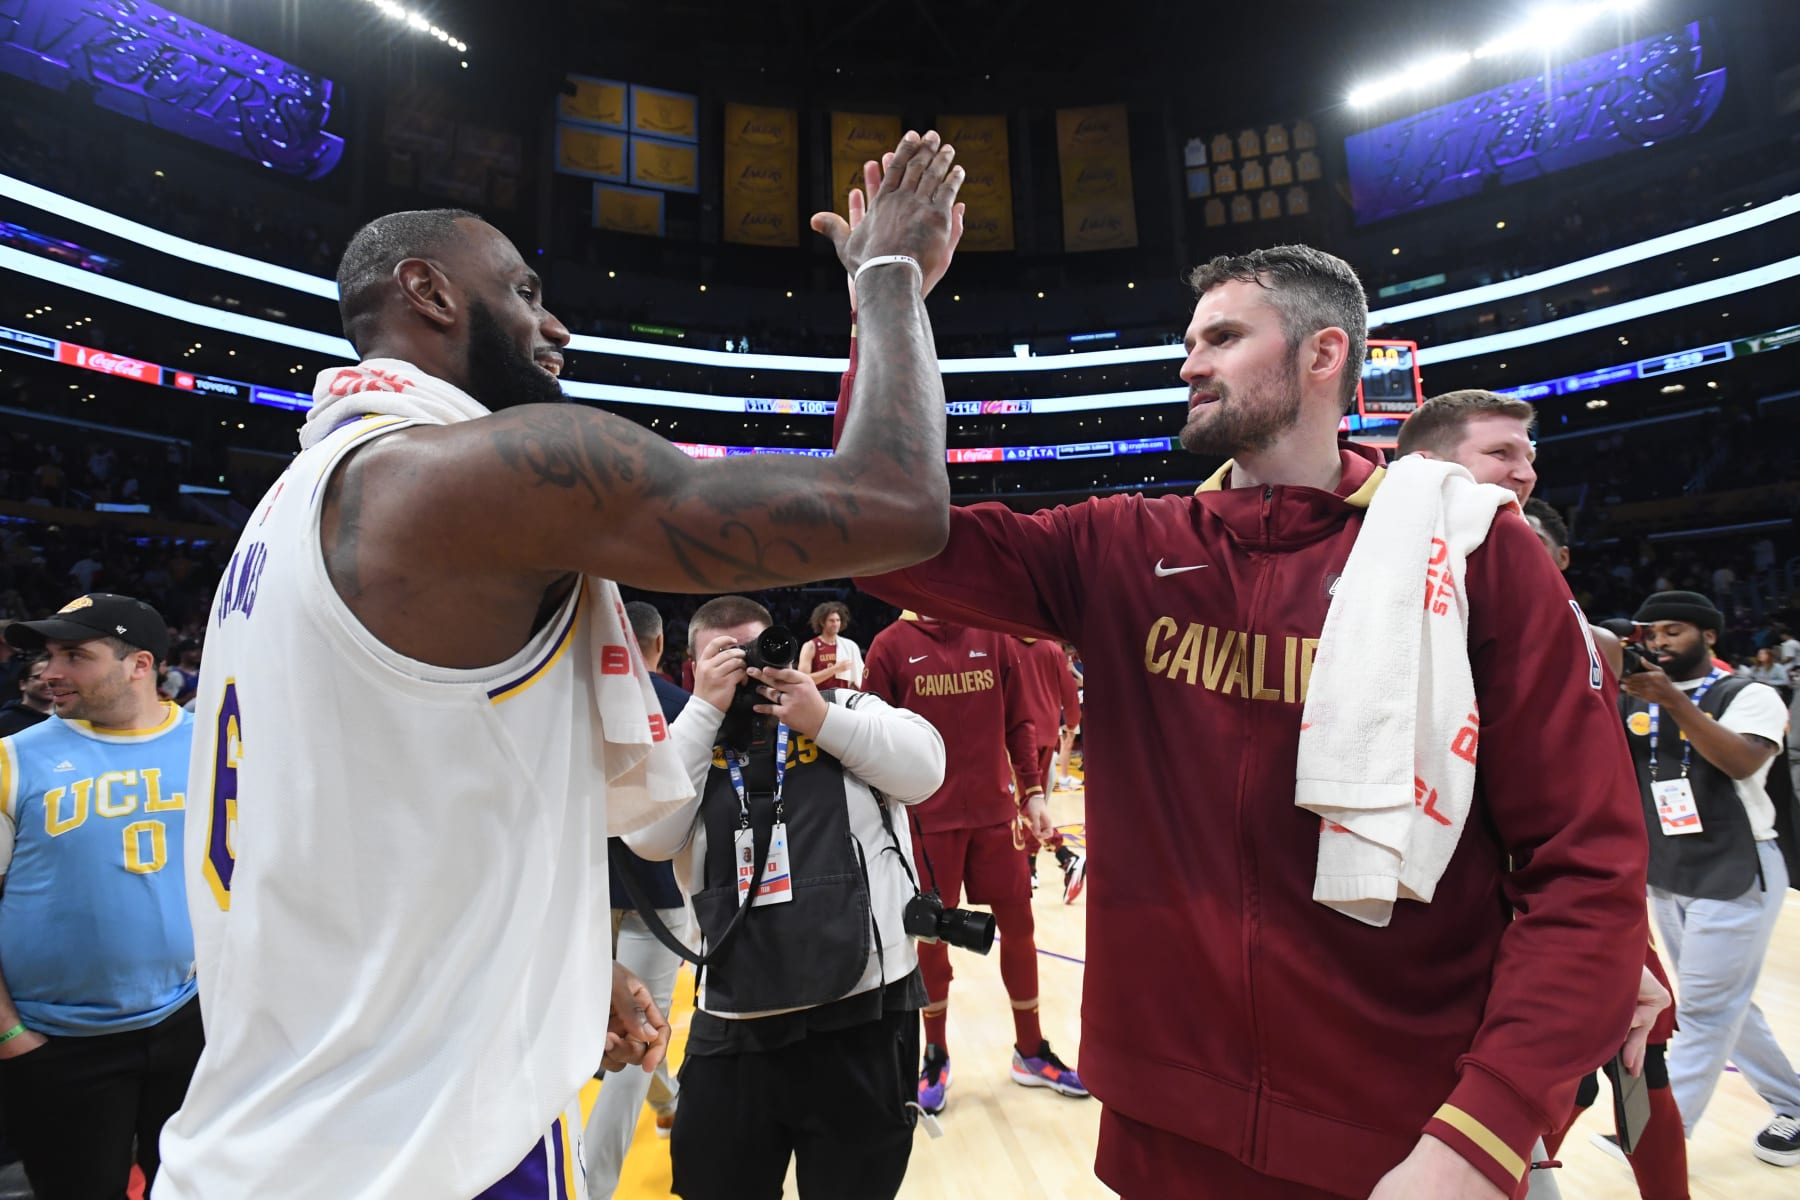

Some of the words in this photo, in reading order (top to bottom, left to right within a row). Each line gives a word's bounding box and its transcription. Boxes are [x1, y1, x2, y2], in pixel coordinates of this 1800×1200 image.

[195, 379, 238, 396] TOYOTA
[801, 401, 823, 413] 100
[957, 403, 978, 414] 114
[678, 444, 723, 458] OSHIBA
[1018, 448, 1054, 458] DELTA
[1128, 441, 1164, 451] crypto.com
[914, 669, 994, 696] CAVALIERS
[42, 768, 186, 838] UCL
[122, 819, 168, 875] 0
